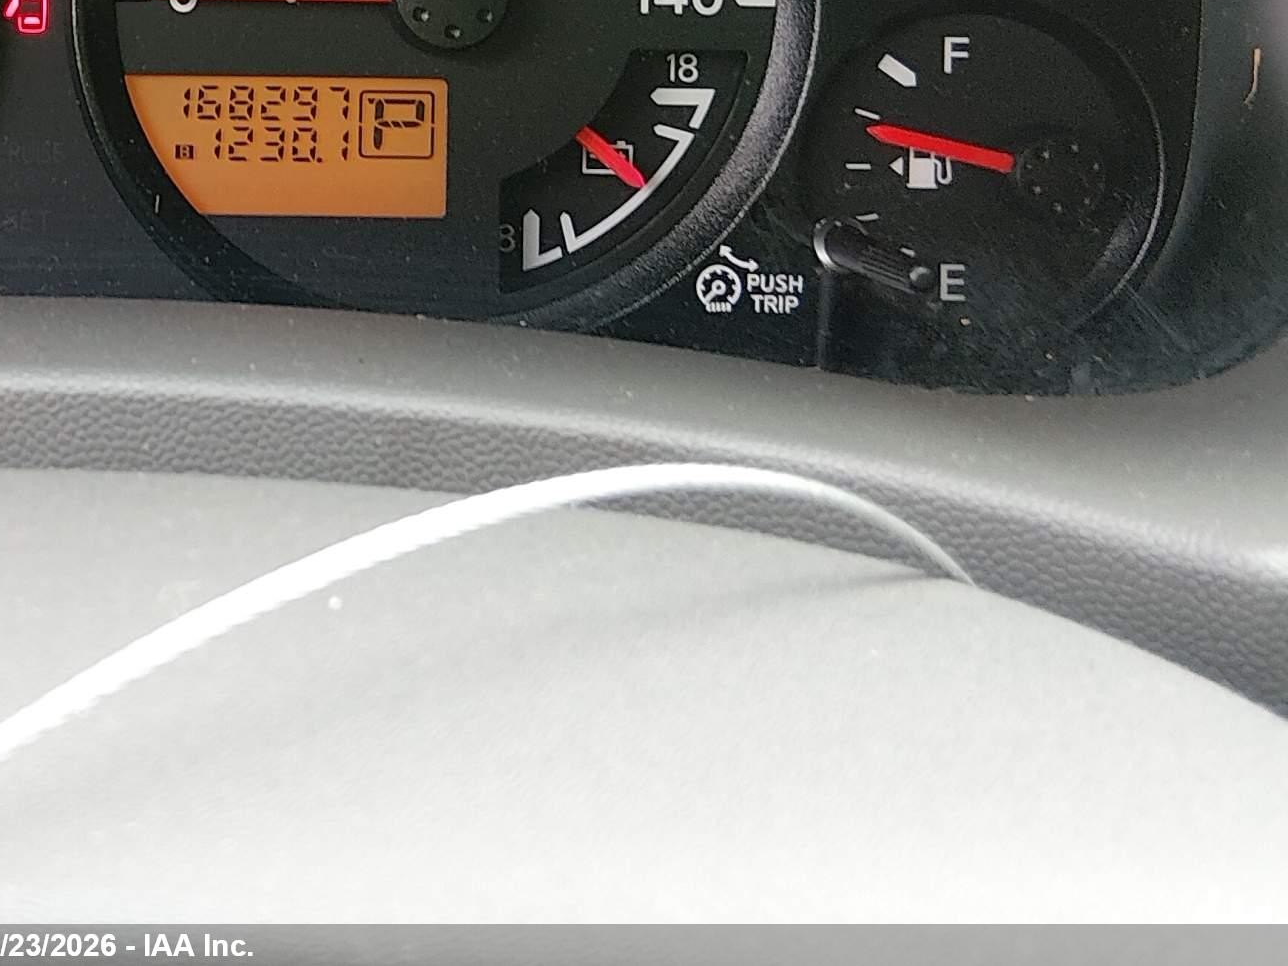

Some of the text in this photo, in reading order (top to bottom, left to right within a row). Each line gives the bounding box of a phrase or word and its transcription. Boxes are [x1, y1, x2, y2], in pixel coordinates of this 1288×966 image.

[667, 54, 699, 83] 18
[943, 37, 970, 74] F
[183, 85, 350, 121] 168297
[372, 98, 425, 150] P
[747, 273, 804, 294] PUSH
[941, 264, 966, 301] E
[750, 293, 800, 314] TRIP
